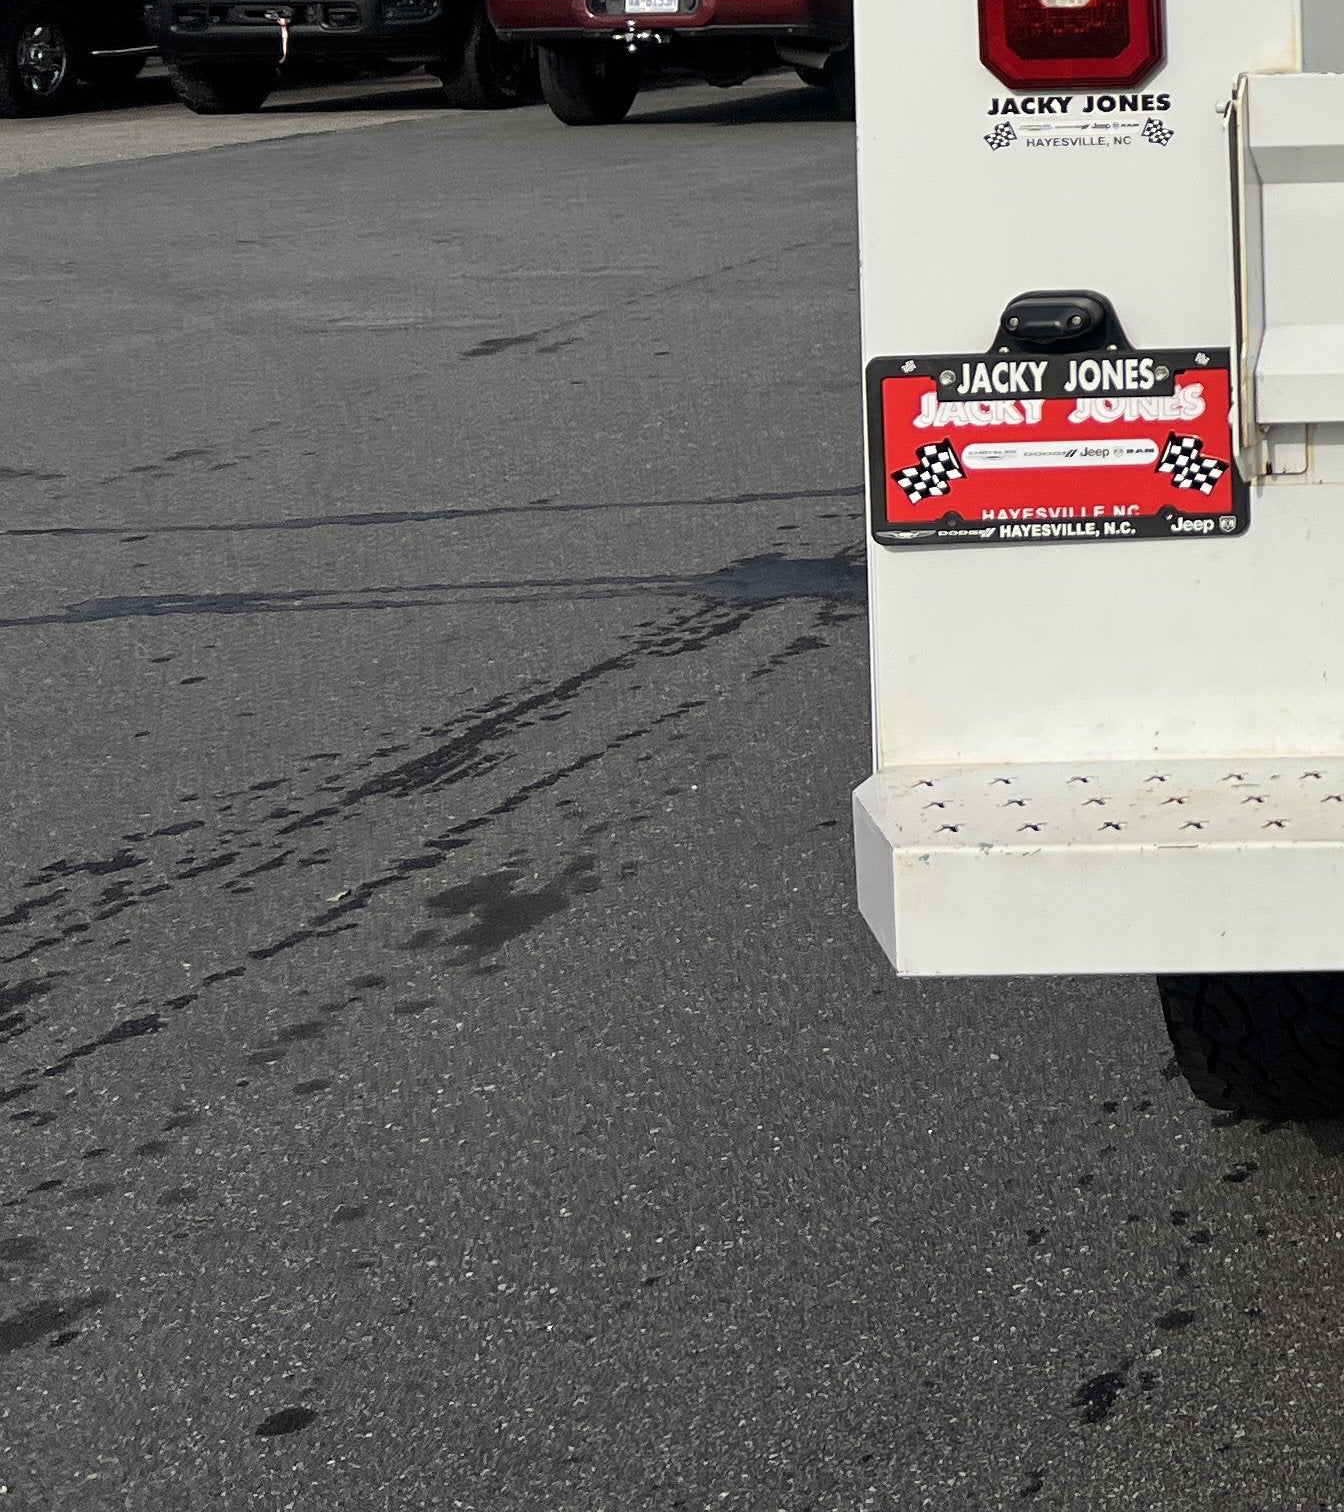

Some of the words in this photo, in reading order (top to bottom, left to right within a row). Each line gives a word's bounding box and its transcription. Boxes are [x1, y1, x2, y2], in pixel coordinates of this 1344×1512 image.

[988, 96, 1073, 115] JACKY
[1082, 93, 1171, 113] JONES
[1026, 136, 1110, 148] HAYESVILLE,
[1114, 136, 1132, 145] NC
[957, 361, 1048, 394] JACKY
[1064, 358, 1155, 392] JONES
[913, 392, 1046, 428] JACKY
[1068, 382, 1206, 424] JONES
[1080, 447, 1110, 459] Jeep
[1000, 522, 1100, 538] HAYESVILLE,
[1103, 521, 1137, 535] N.C.
[1171, 516, 1215, 534] Jeep
